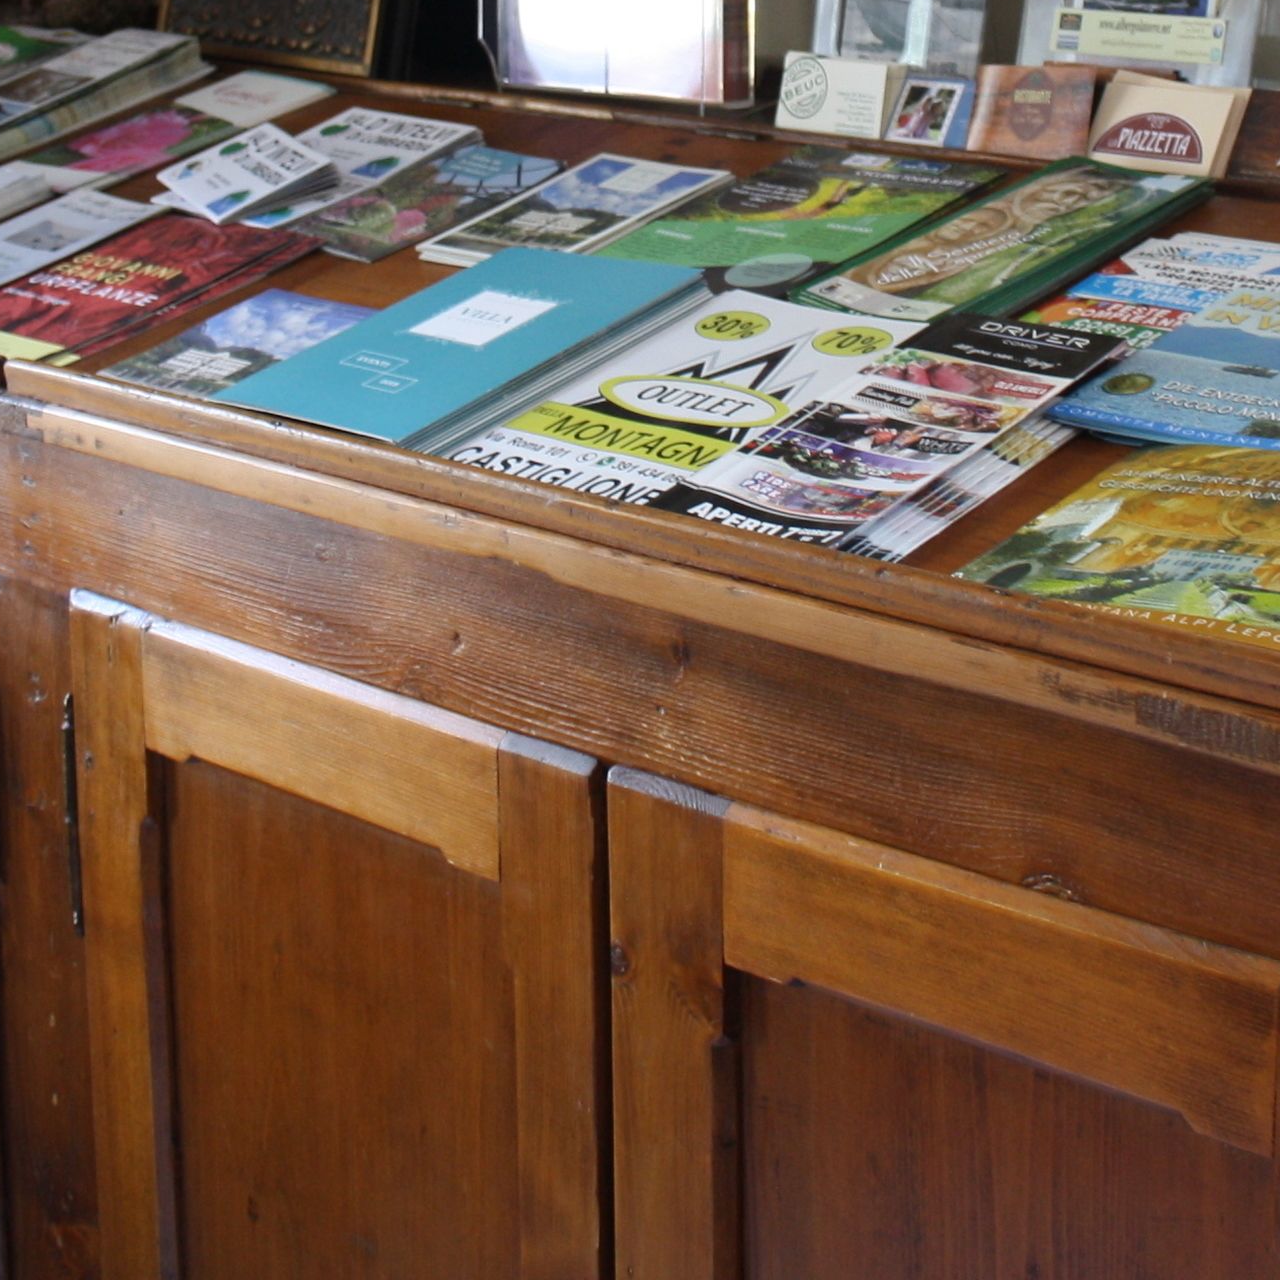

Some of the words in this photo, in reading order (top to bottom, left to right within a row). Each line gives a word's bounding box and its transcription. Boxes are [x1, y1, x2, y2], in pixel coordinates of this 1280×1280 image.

[1118, 127, 1192, 156] PIAZZETTA
[28, 272, 160, 307] URPFLANZE
[701, 315, 765, 339] 30%
[1205, 309, 1250, 325] IN
[821, 331, 886, 355] 70%
[979, 320, 1091, 350] DRIVER
[636, 384, 756, 419] OUTLET
[1161, 380, 1194, 395] DIE
[483, 430, 502, 442] Via
[509, 436, 546, 452] Roma
[546, 446, 573, 459] 101
[687, 501, 784, 536] APERTI
[1166, 612, 1216, 629] ALPI
